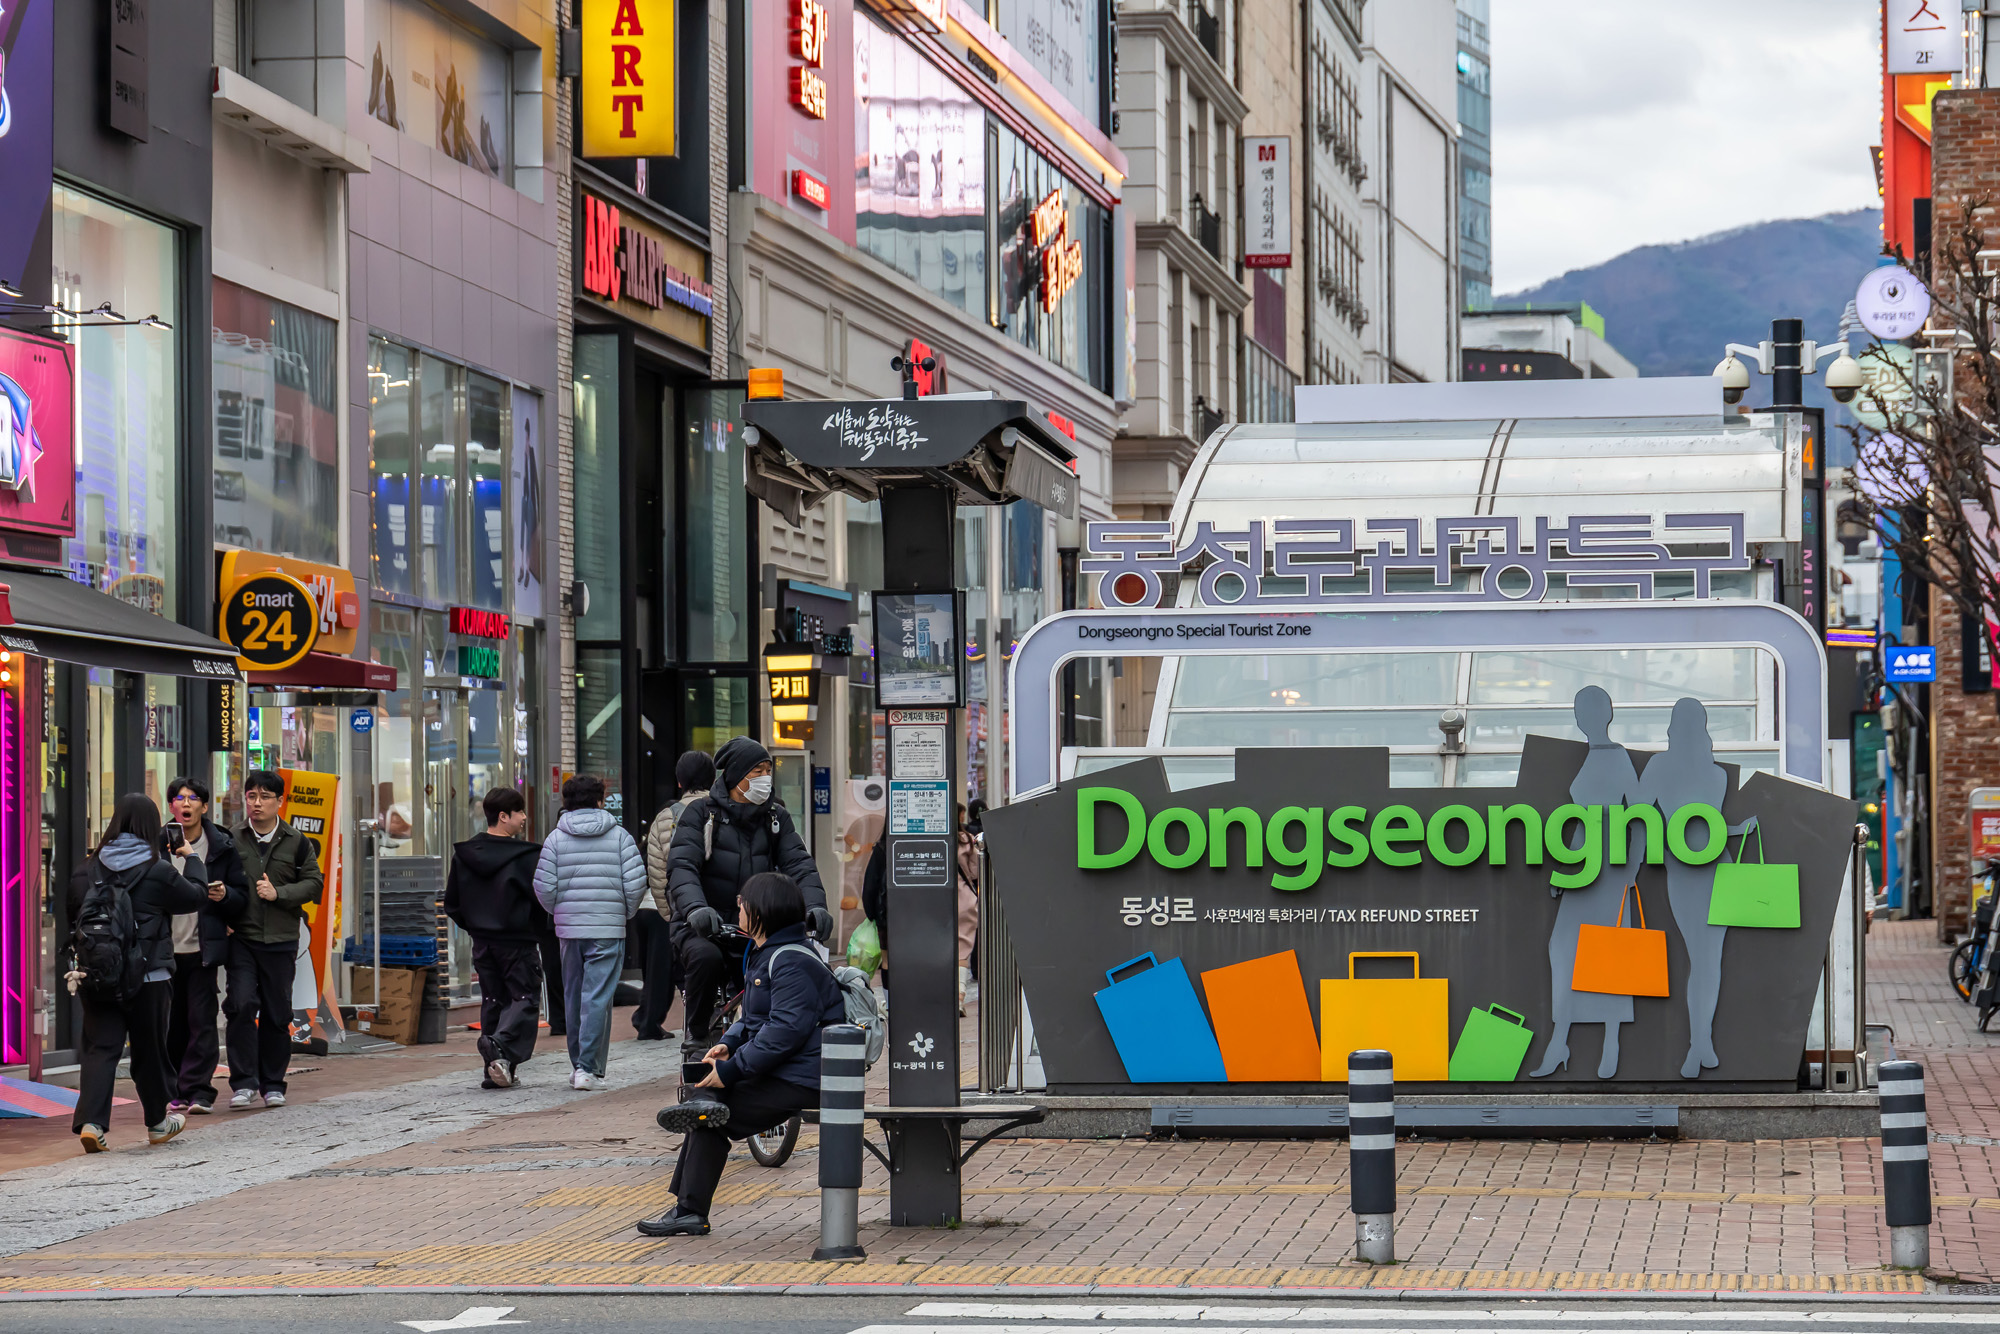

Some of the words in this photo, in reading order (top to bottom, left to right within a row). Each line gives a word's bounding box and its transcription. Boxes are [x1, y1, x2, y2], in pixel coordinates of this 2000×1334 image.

[1915, 51, 1935, 64] 2F
[1258, 145, 1276, 162] M
[584, 194, 664, 310] ABC-MART
[822, 406, 865, 447] 새롭게
[865, 403, 919, 431] 도약하는
[843, 429, 895, 461] 행복도시
[896, 427, 929, 451] 중구
[1802, 437, 1815, 470] 4
[1079, 511, 1752, 609] 동성로관광특구
[242, 591, 295, 608] emart
[242, 610, 298, 651] 24
[459, 607, 509, 640] KUMKANG
[1078, 625, 1174, 641] Dongseongno
[1176, 624, 1226, 640] Special
[1228, 623, 1274, 637] Tourist
[1276, 623, 1312, 636] Zone
[221, 684, 230, 709] CASE
[771, 676, 809, 698] 커피
[354, 716, 370, 725] ADT
[903, 711, 924, 721] 관계자외
[924, 711, 946, 721] 작동금지
[221, 709, 230, 748] MANGO
[286, 794, 324, 806] HGHLIGHT
[292, 785, 306, 795] ALL
[306, 786, 320, 796] DAY
[292, 816, 322, 833] NEW
[1077, 786, 1728, 892] Dongseongno
[1119, 896, 1197, 927] 동성로
[1203, 908, 1266, 924] 사후면세점
[1267, 908, 1318, 924] 특화거리
[1328, 909, 1357, 923] TAX
[1360, 909, 1422, 923] REFUND
[1425, 909, 1480, 923] STREET
